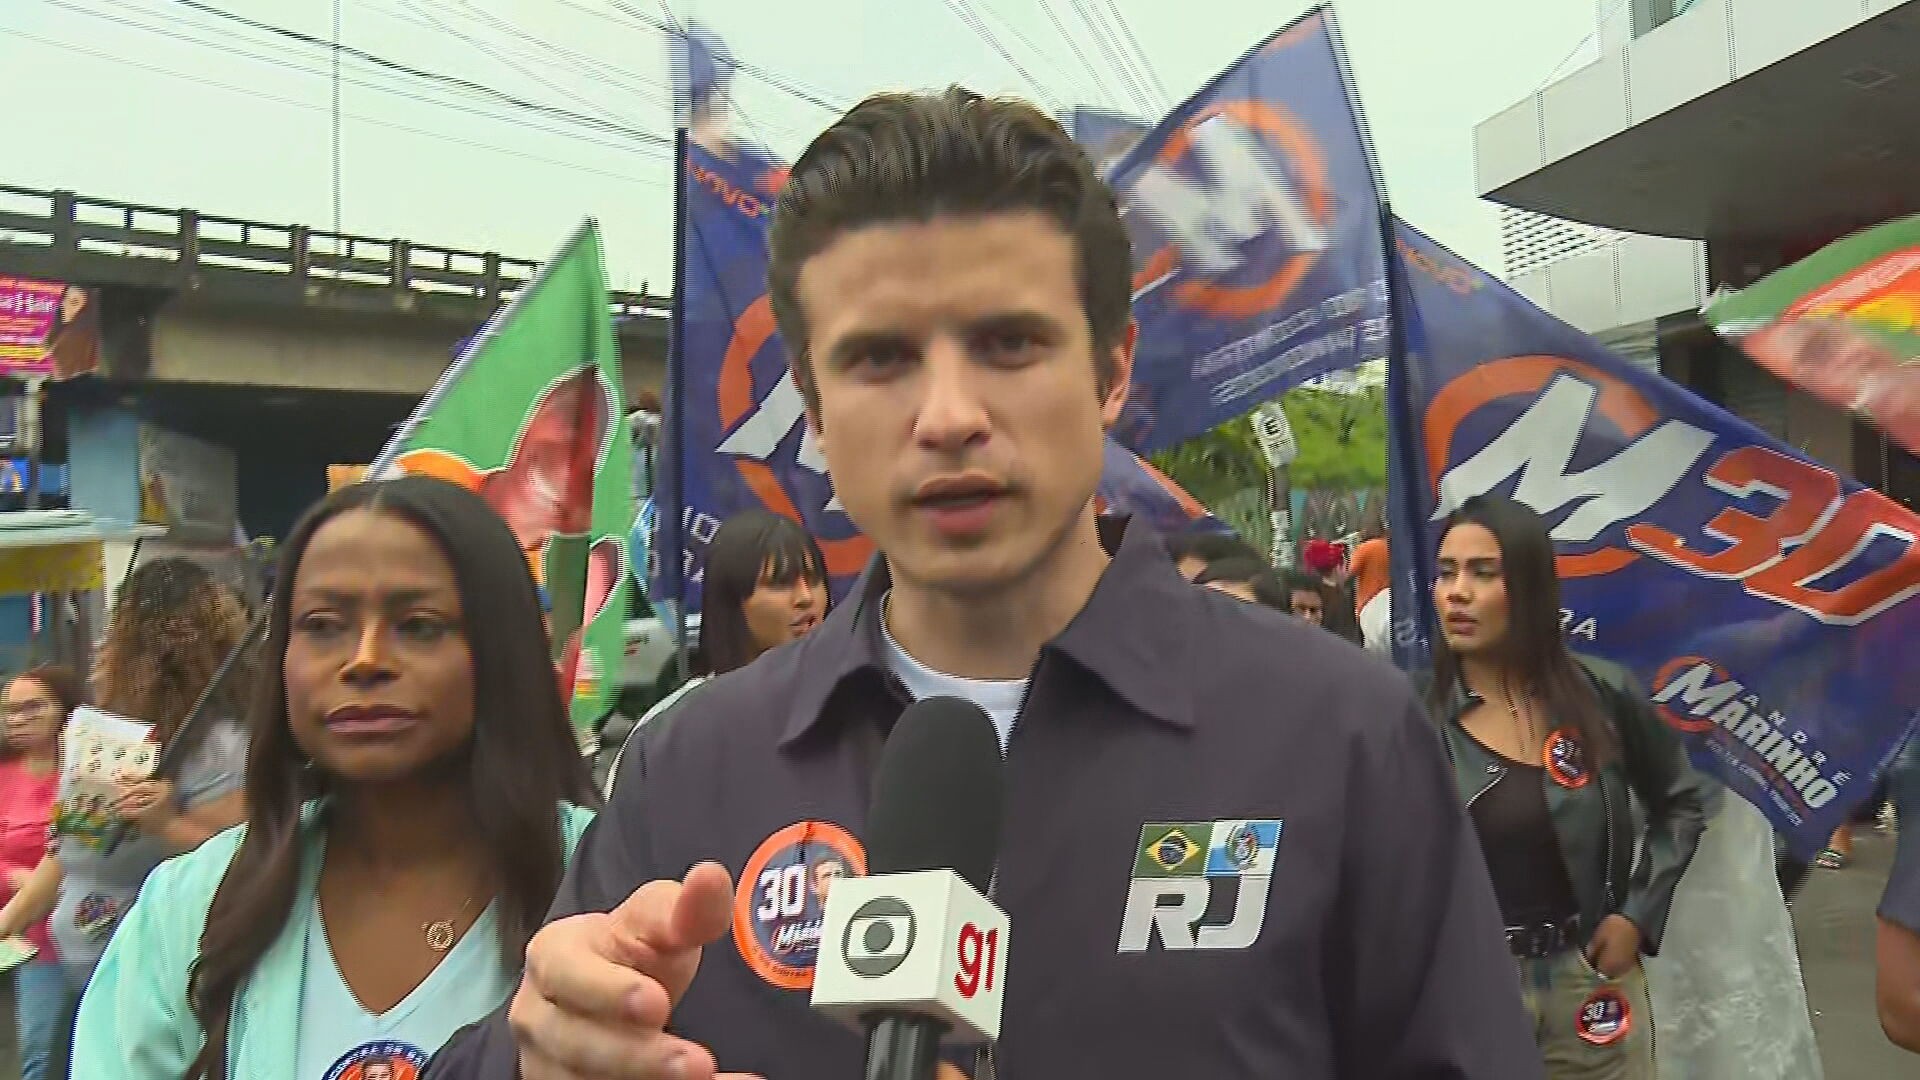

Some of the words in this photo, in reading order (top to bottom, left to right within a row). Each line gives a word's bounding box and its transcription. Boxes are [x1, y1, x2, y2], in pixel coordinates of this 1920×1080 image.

[1265, 417, 1281, 436] E
[1650, 662, 1839, 809] MARINHO
[757, 863, 807, 921] 30
[1116, 876, 1273, 954] RJ
[1584, 1000, 1605, 1022] 30
